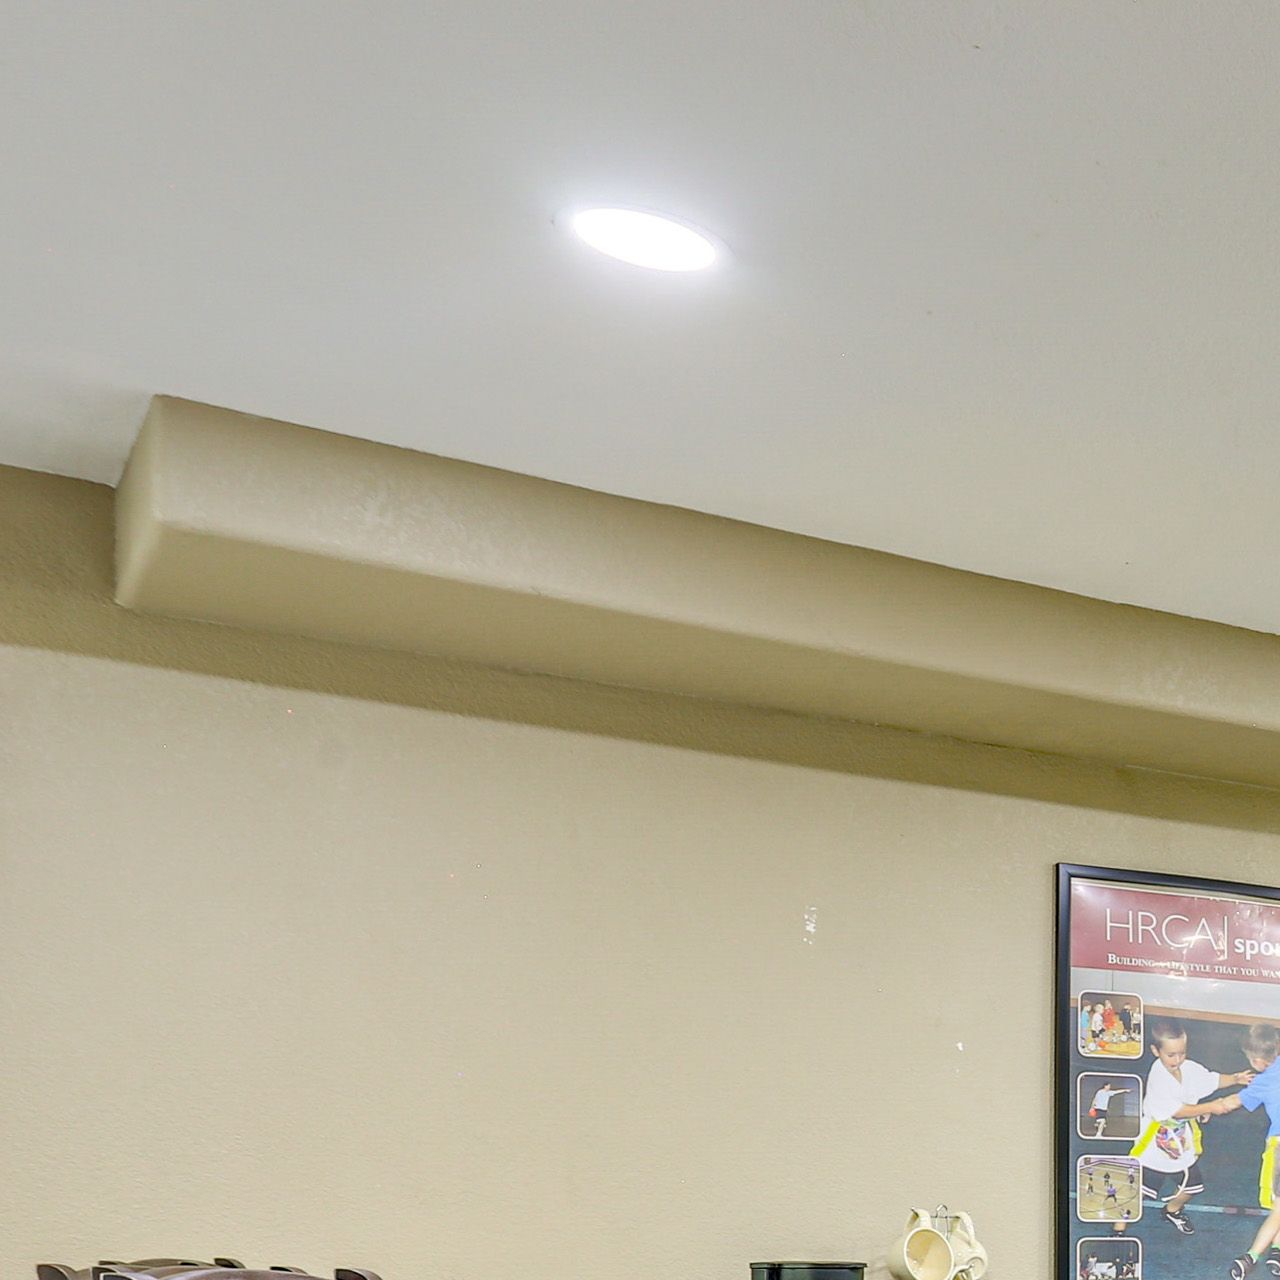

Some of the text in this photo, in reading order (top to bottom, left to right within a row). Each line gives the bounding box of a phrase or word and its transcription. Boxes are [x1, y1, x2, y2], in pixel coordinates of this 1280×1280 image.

[1105, 908, 1218, 950] HRCA
[1214, 965, 1238, 975] THAT
[1240, 967, 1259, 977] YOU
